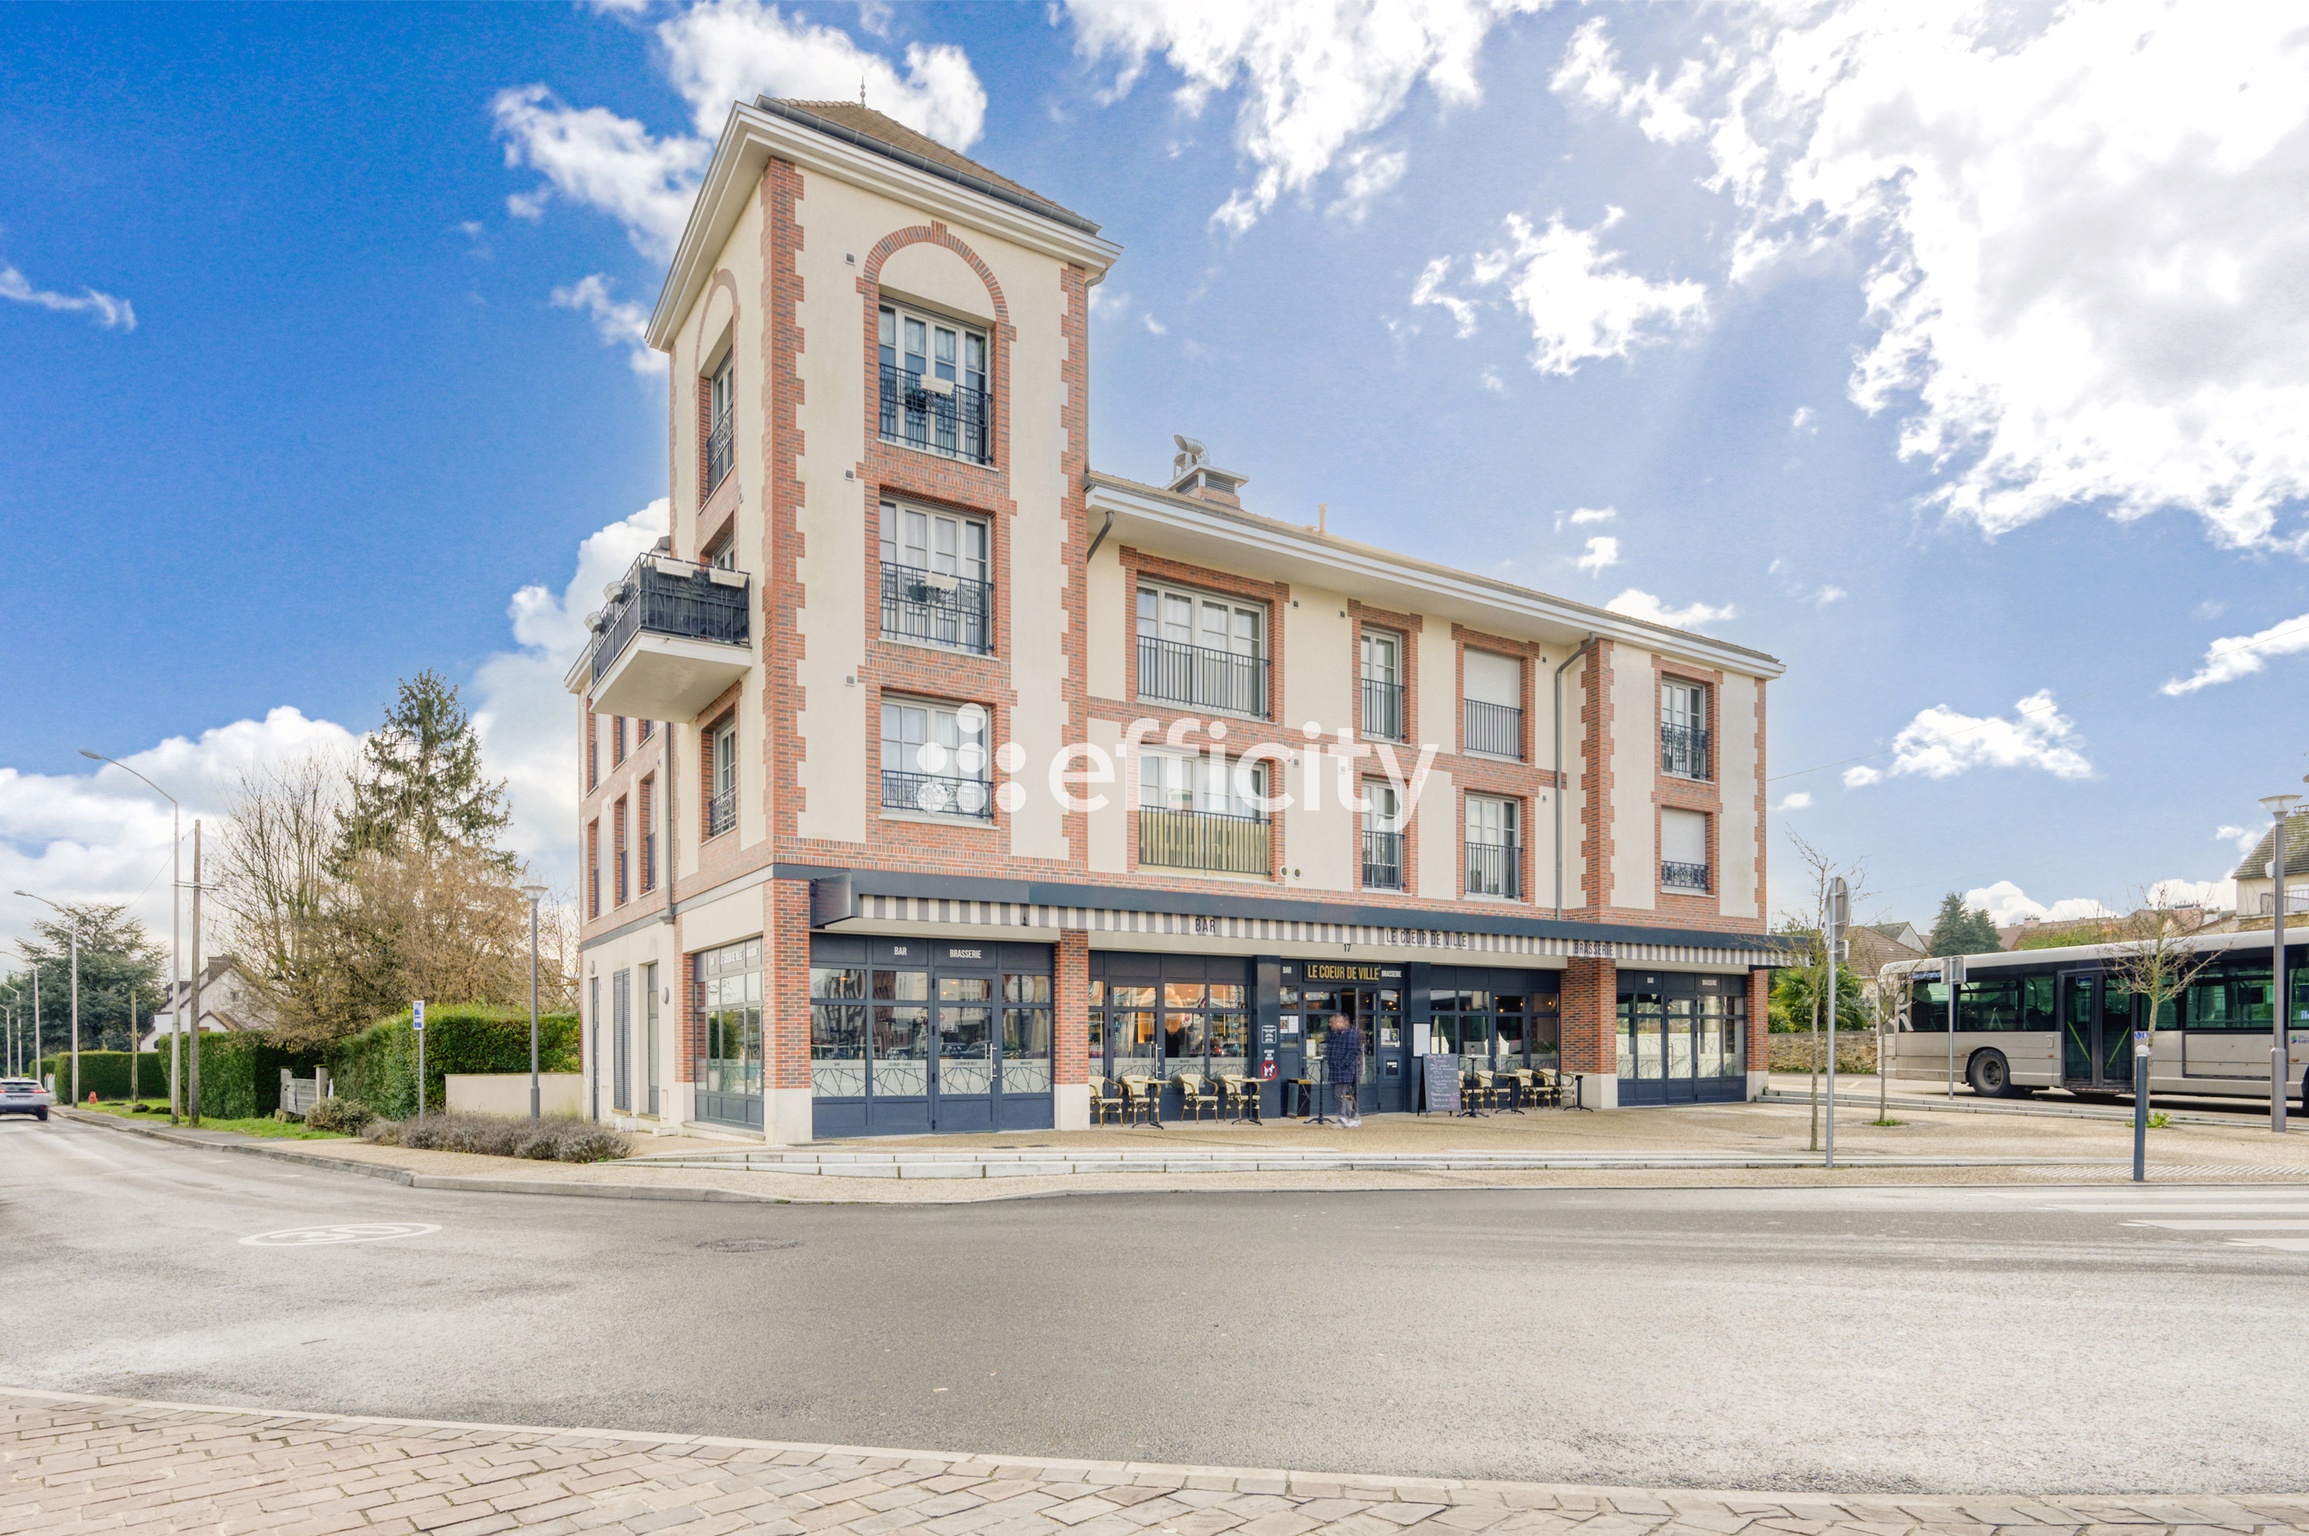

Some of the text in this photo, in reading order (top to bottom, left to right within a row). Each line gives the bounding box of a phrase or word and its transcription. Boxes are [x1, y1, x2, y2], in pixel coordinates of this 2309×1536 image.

[1195, 918, 1215, 933] BAR
[1386, 930, 1467, 947] LE COEUR DE VILLE
[893, 946, 908, 956] BAR
[1343, 943, 1352, 952] 17
[1574, 942, 1614, 956] BRASSERIE
[949, 949, 982, 959] BRASSERIE
[1282, 966, 1292, 974] BAR
[1307, 964, 1380, 981] LE COEUR DE VILLE
[1381, 970, 1402, 978] BRASSERIE
[268, 1224, 412, 1242] 30
